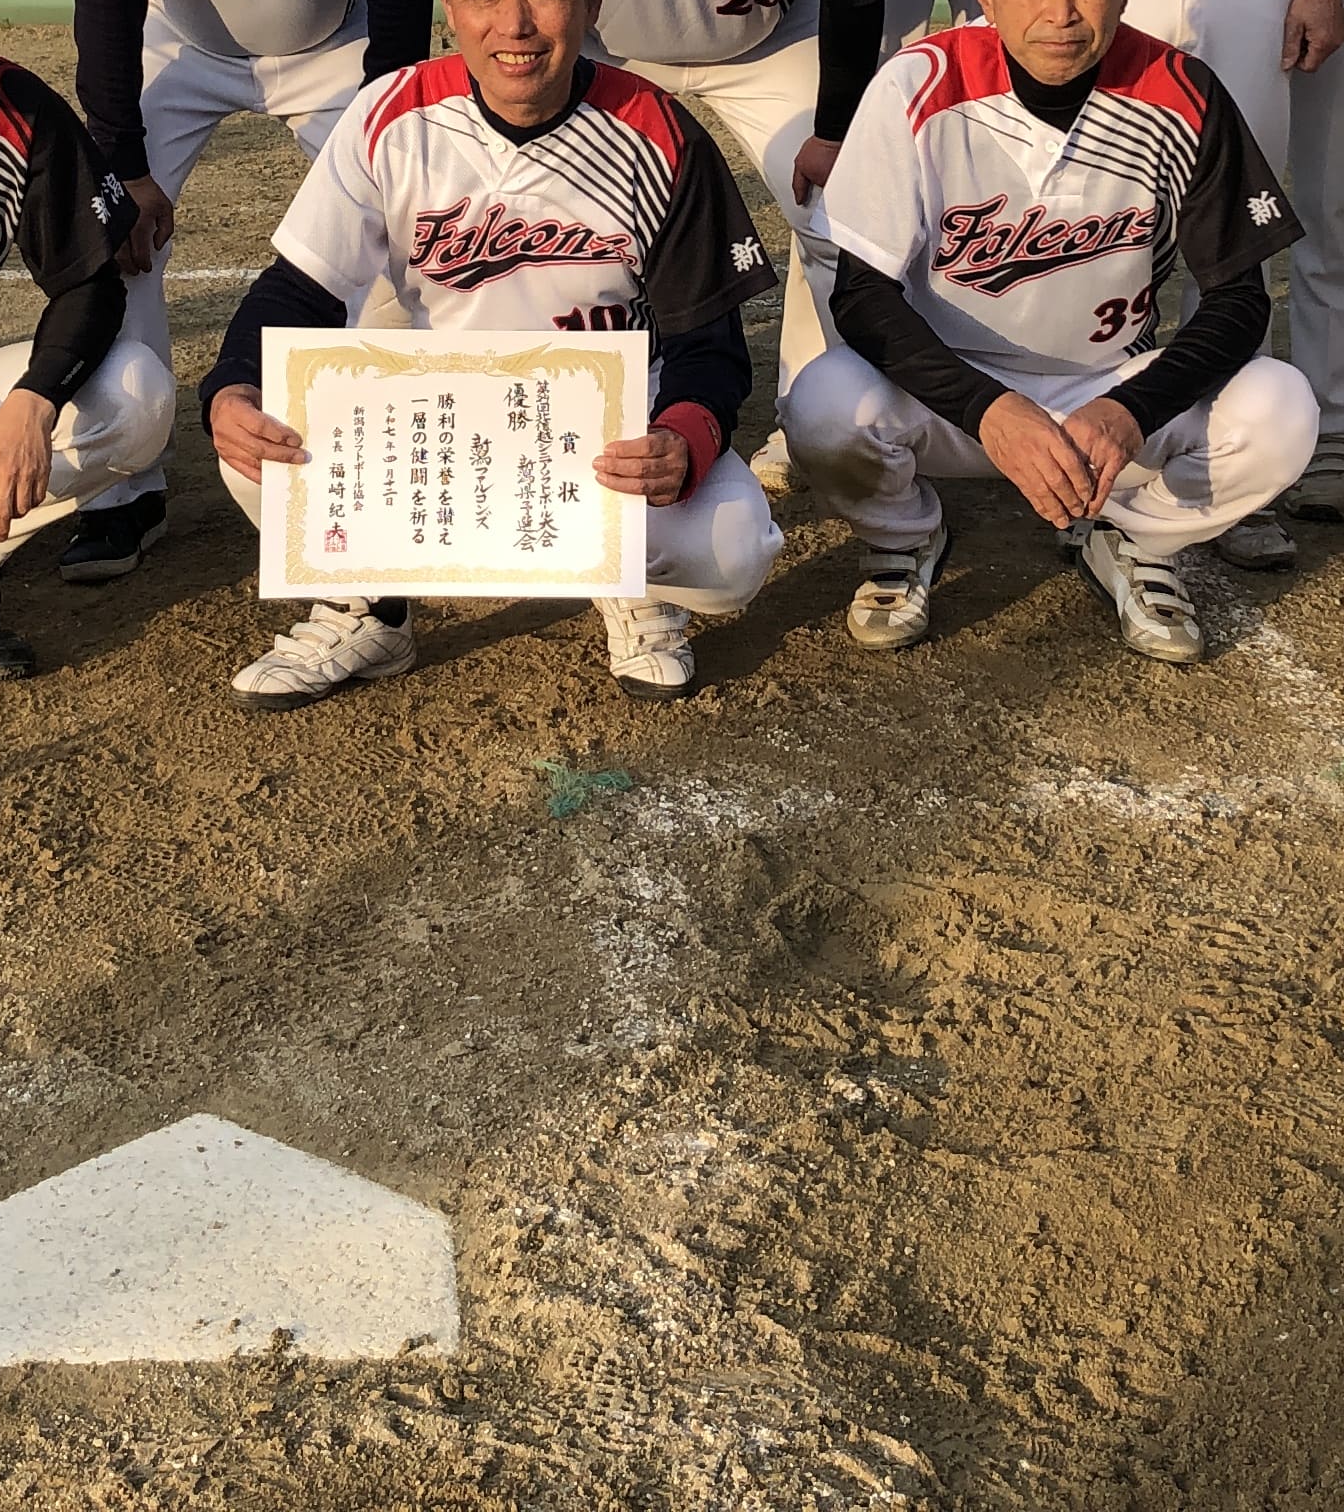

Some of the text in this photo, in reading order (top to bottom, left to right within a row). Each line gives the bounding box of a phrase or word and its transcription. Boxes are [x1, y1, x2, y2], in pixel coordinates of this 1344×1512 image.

[407, 197, 638, 293] Falcons
[1246, 191, 1281, 226] 新
[730, 236, 767, 273] 新
[332, 426, 343, 453] 会長
[504, 382, 533, 432] 優勝
[353, 405, 365, 512] 新潟県ソフトボール協会
[382, 403, 398, 506] 令和七年四月十二日
[410, 396, 429, 544] 一層の健闘を祈る
[468, 433, 494, 530] 新潟ファルコンズ
[558, 431, 581, 503] 賞状
